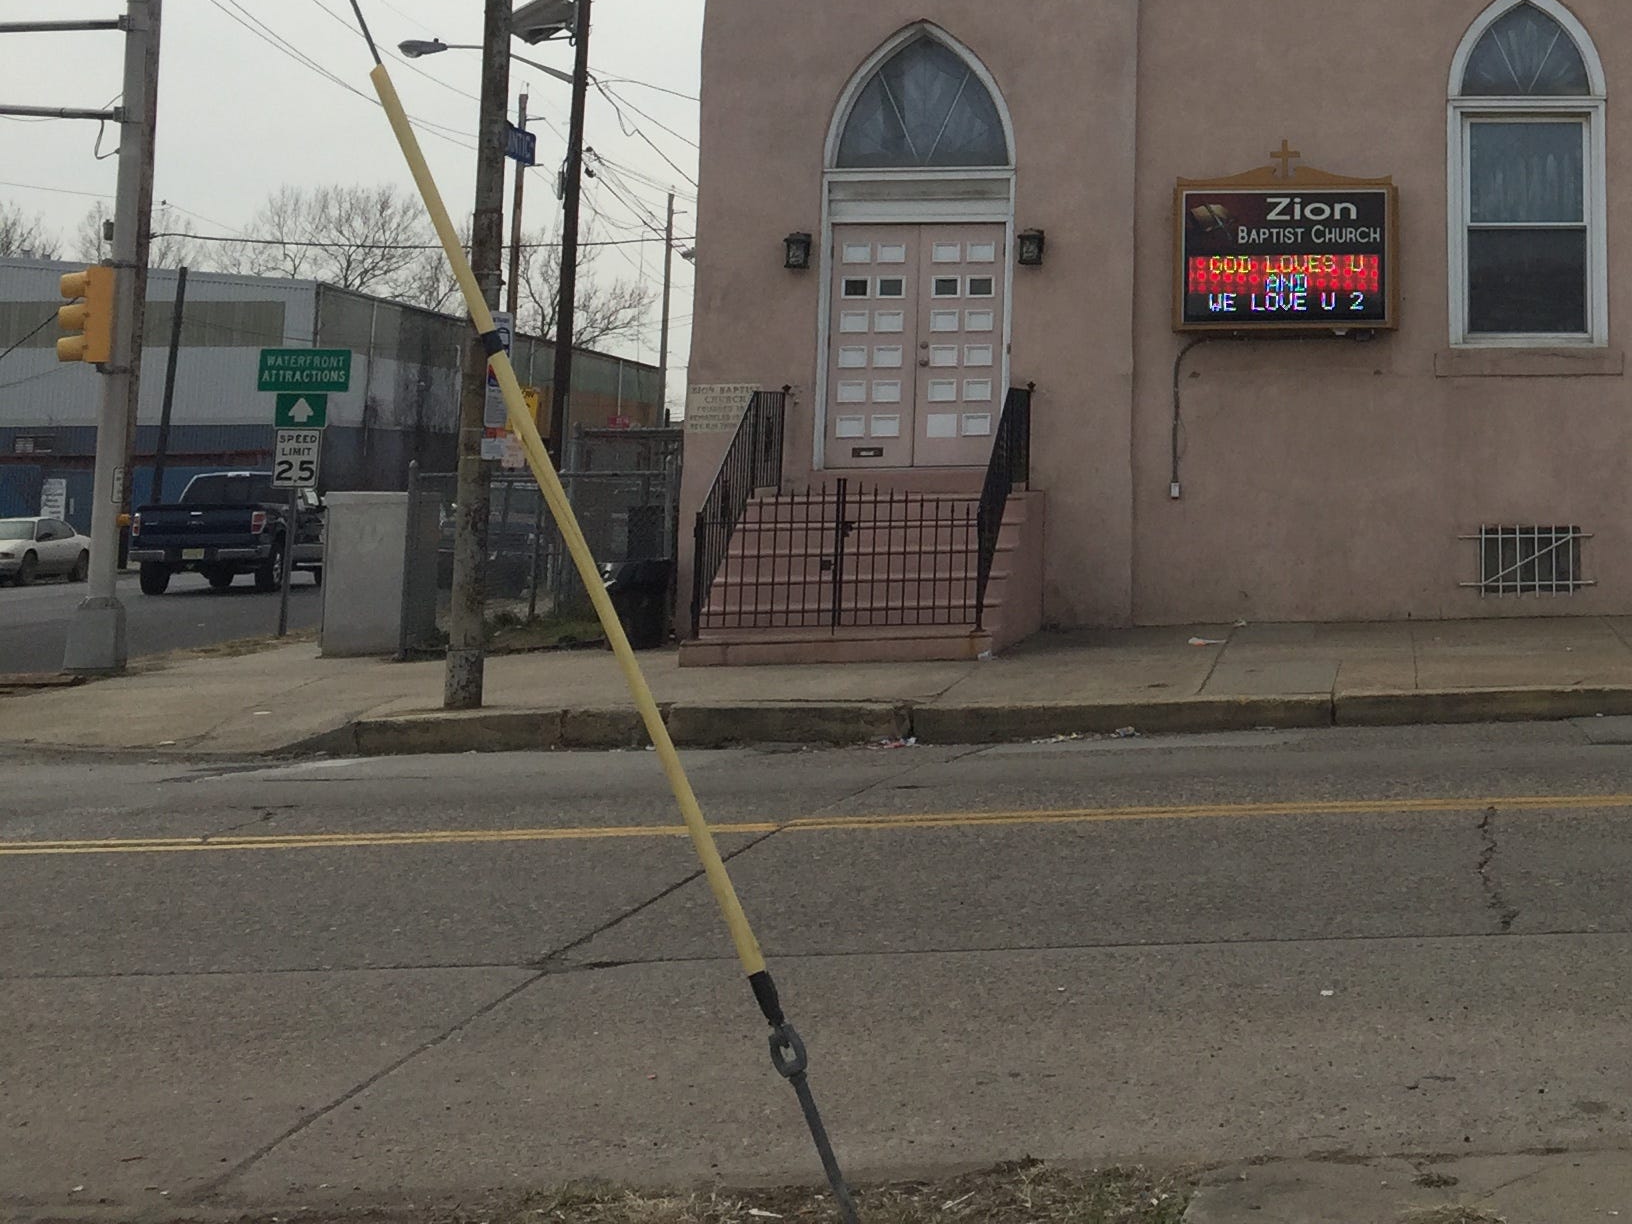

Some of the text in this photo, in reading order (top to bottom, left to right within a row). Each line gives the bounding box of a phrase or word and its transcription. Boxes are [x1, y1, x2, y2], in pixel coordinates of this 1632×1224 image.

[1266, 197, 1357, 221] Zion
[1237, 225, 1381, 244] BAPTIST CHURCH
[1209, 254, 1364, 273] GOD LOVES U
[1265, 273, 1308, 292] AND
[1209, 291, 1364, 312] WE LOVE U 2
[266, 355, 345, 368] WATERFRONT
[261, 370, 346, 383] ATTRACTIONS
[279, 434, 318, 444] SPEED
[281, 447, 313, 457] LIMIT
[275, 459, 315, 482] 25
